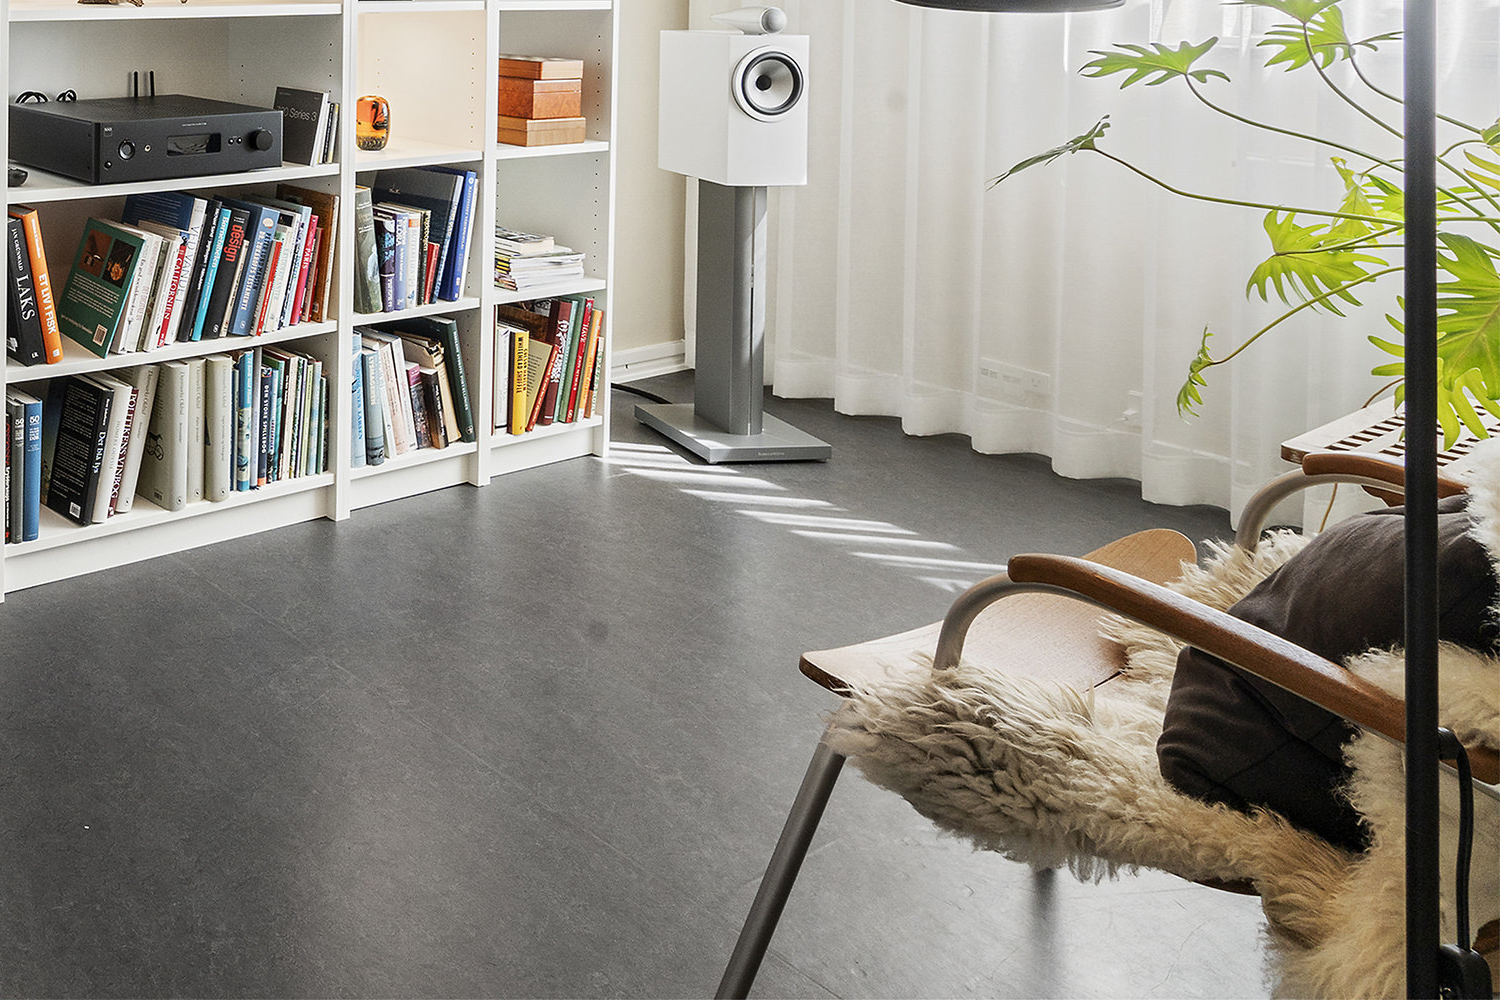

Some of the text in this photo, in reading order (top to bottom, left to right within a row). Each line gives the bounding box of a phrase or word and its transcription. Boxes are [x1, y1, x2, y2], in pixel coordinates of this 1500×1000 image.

[289, 107, 311, 121] Series
[311, 111, 318, 122] 3
[224, 225, 241, 262] design
[302, 248, 311, 270] PARIS
[16, 275, 35, 321] LAKS
[39, 273, 56, 334] ET LIV FISK
[164, 258, 183, 320] CALIFORNIEN
[98, 431, 106, 447] Det
[119, 393, 137, 455] POLITIKENS
